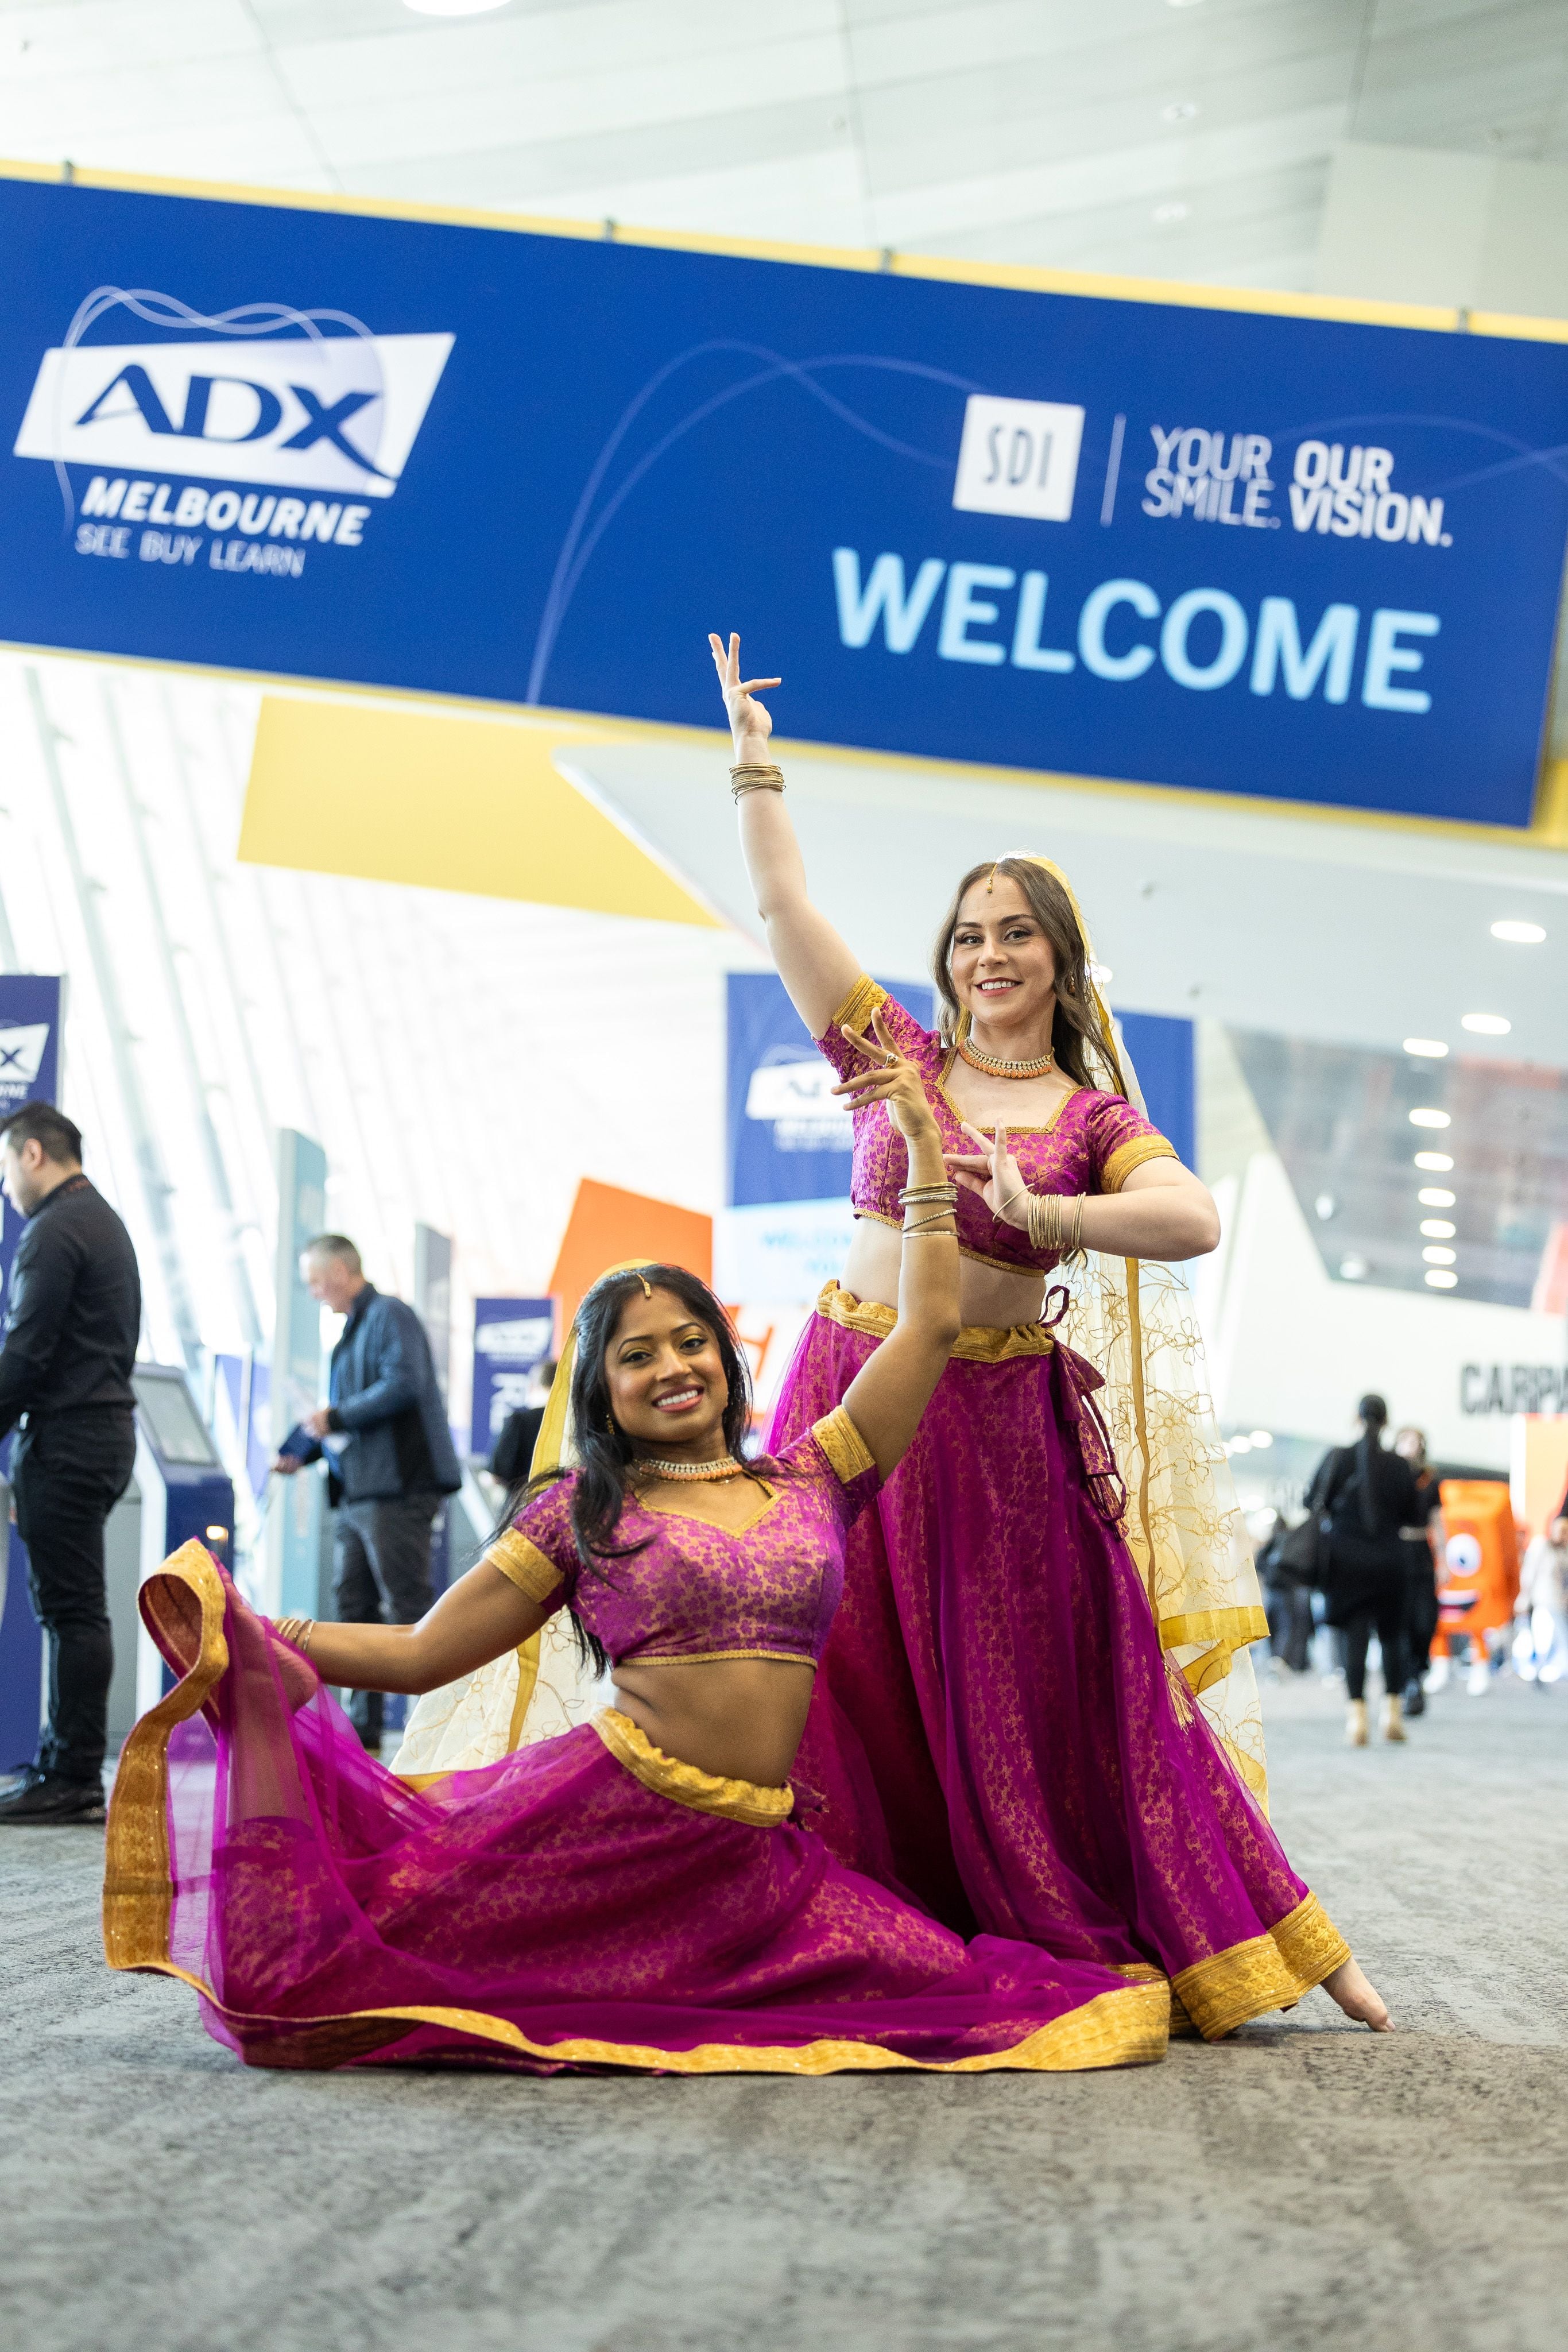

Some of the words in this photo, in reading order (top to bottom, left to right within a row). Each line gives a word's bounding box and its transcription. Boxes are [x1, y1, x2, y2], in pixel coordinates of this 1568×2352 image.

[73, 364, 397, 481] ADX
[1150, 424, 1272, 481] YOUR
[982, 425, 1054, 489] SDI
[1294, 440, 1394, 493] OUR
[82, 476, 371, 546] MELBOURNE
[1141, 467, 1281, 529] SMILE.
[1288, 483, 1453, 547] VISION.
[75, 523, 133, 559] SEE
[139, 529, 203, 566] BUY
[209, 538, 306, 578] LEARN
[832, 547, 1441, 715] WELCOME
